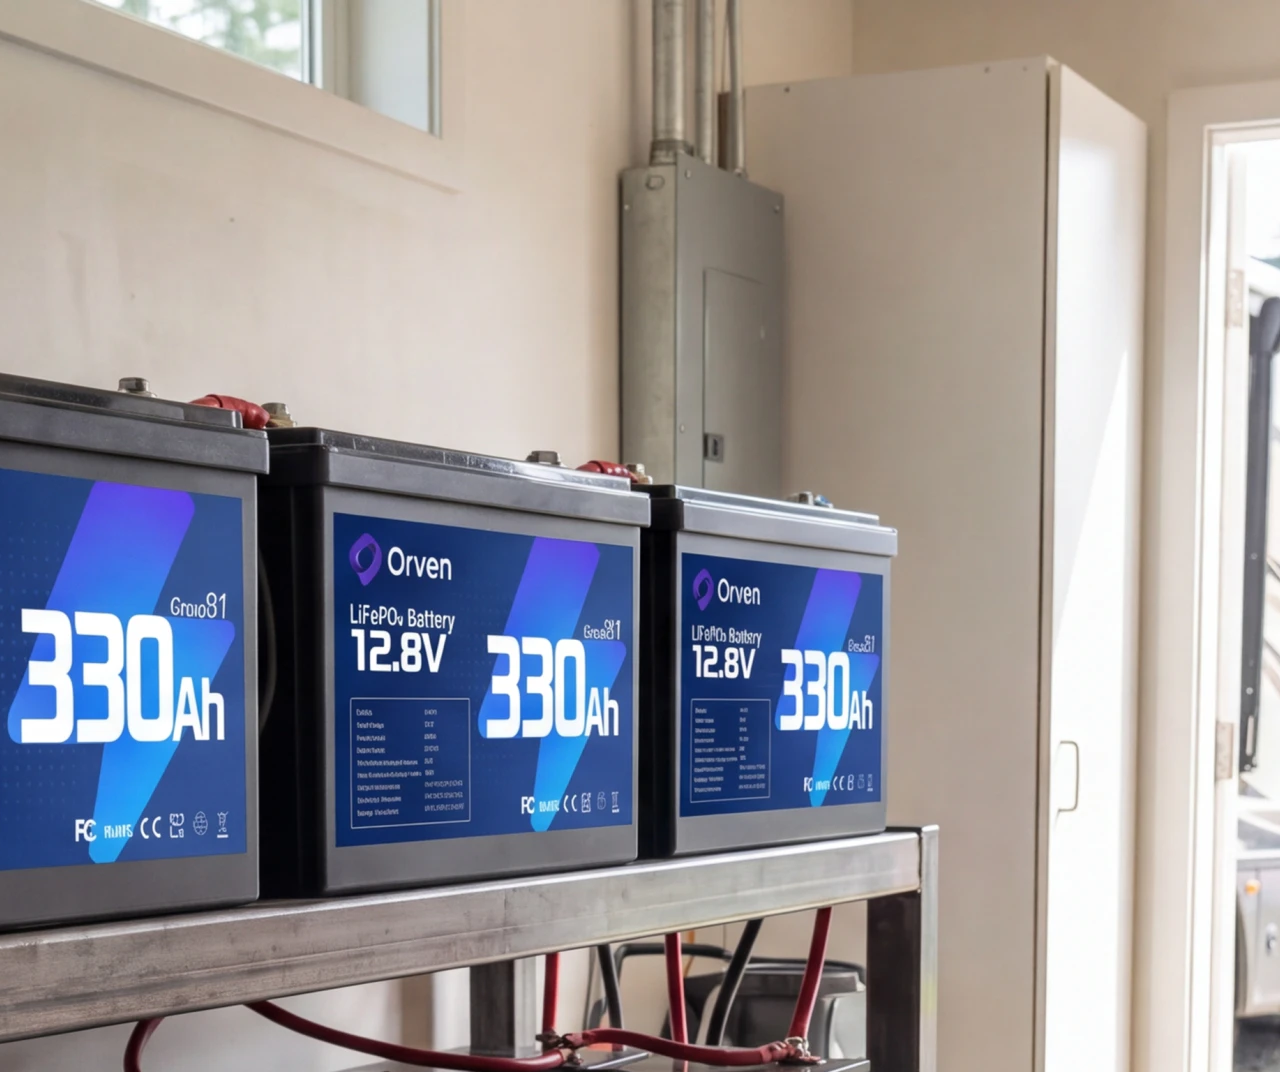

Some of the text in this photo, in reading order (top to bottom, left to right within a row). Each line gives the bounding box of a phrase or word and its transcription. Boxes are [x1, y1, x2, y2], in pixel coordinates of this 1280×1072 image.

[387, 546, 452, 581] Orven
[717, 578, 761, 605] Orven
[407, 608, 456, 635] Battery
[351, 628, 447, 673] 12.8V
[692, 644, 756, 679] 12.8V
[20, 608, 225, 744] 330Ah
[486, 634, 619, 739] 330Ah
[780, 648, 873, 731] 330Ah
